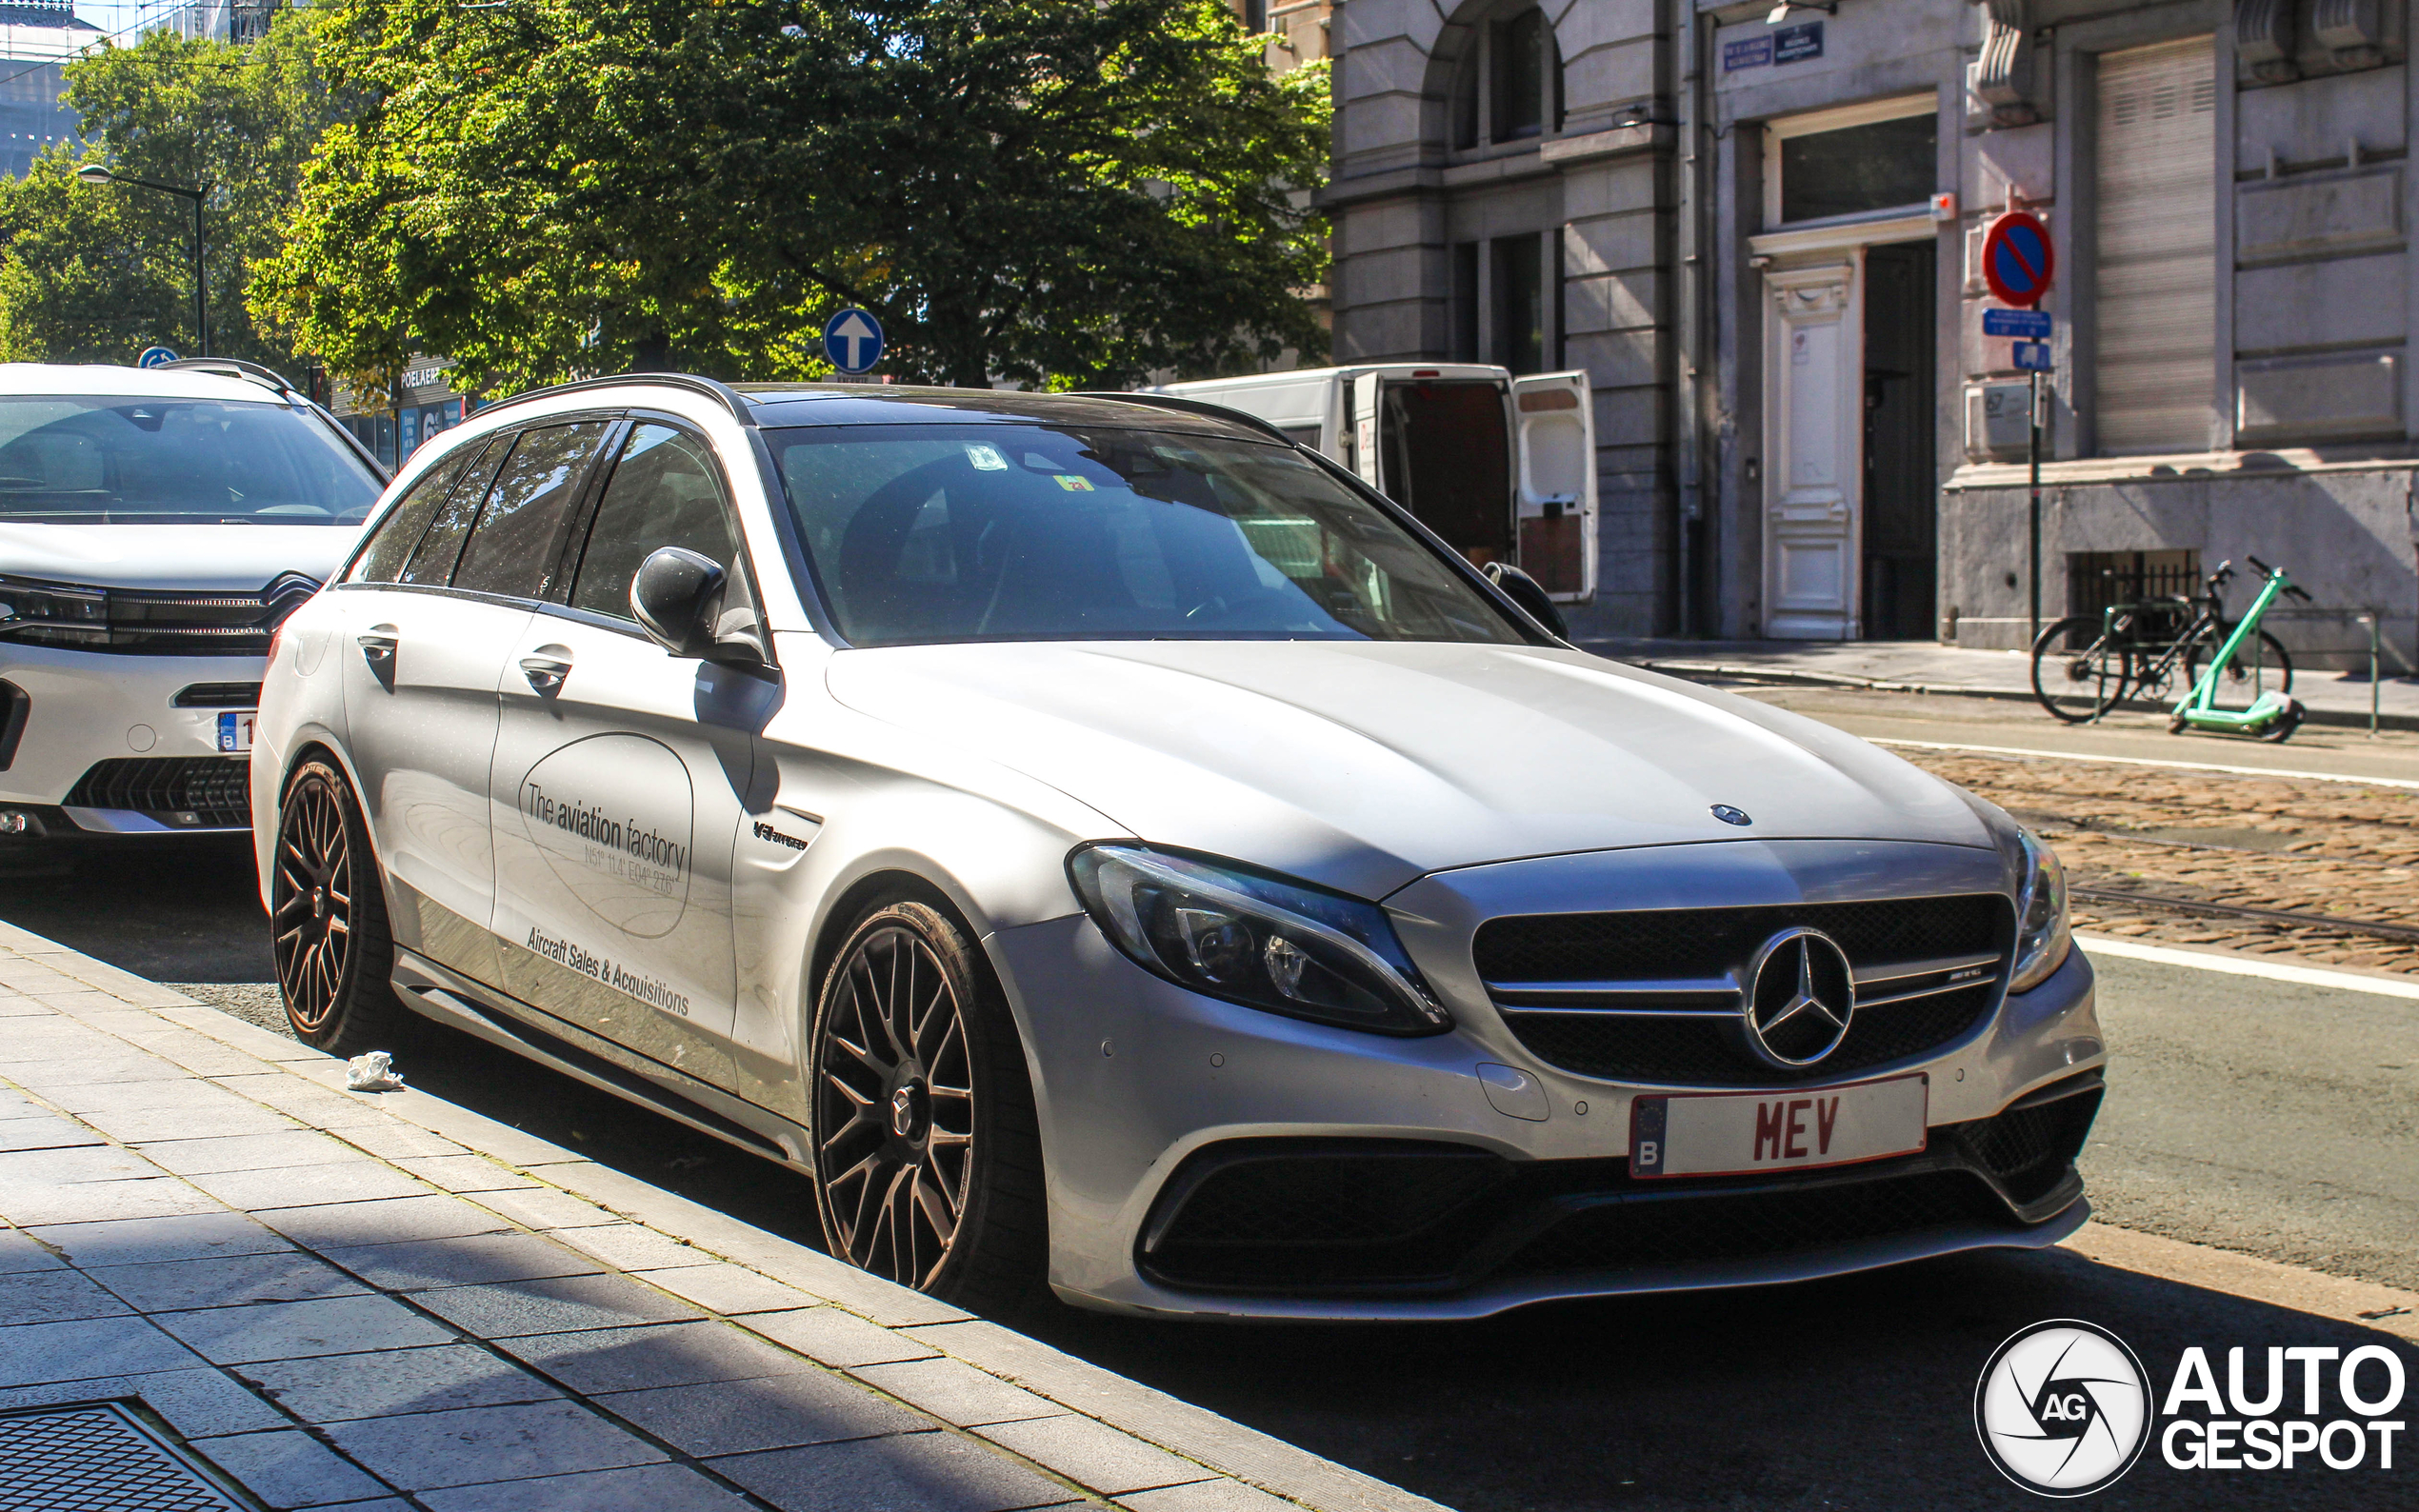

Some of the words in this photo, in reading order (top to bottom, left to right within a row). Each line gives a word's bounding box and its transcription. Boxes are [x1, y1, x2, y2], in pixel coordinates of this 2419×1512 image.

[223, 735, 233, 748] B
[529, 783, 554, 825] The
[558, 800, 621, 850] aviation
[627, 818, 686, 883] factory
[527, 926, 568, 964] Aircraft
[569, 944, 599, 978] Sales
[601, 959, 610, 983] &
[612, 964, 690, 1017] Acquisitions
[1639, 1142, 1658, 1165] B
[1753, 1096, 1839, 1161] MEV
